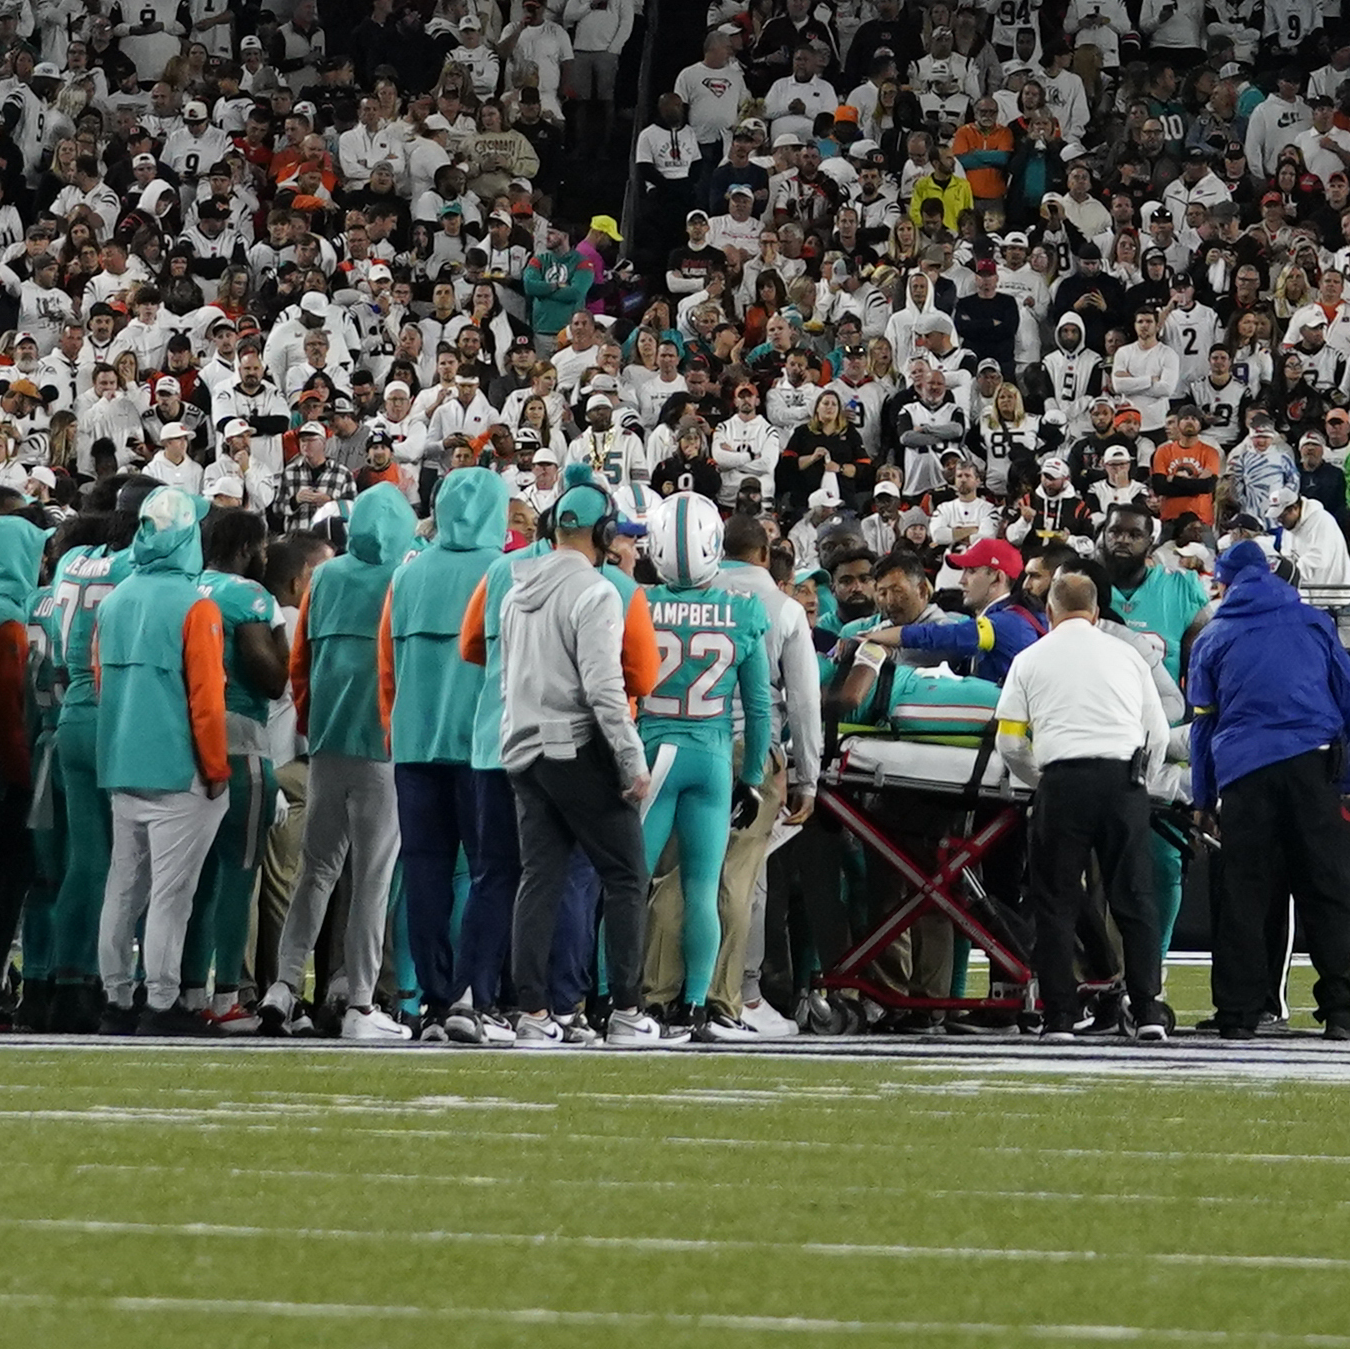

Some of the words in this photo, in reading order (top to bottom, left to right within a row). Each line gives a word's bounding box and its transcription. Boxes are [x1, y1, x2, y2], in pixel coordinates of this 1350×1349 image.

[999, 0, 1031, 26] 94
[1288, 14, 1301, 41] 9
[1159, 115, 1183, 141] 10
[184, 154, 199, 176] 9
[1182, 328, 1198, 355] 2
[1062, 373, 1077, 401] 9
[650, 602, 736, 628] AMPBELL
[642, 630, 735, 716] 22
